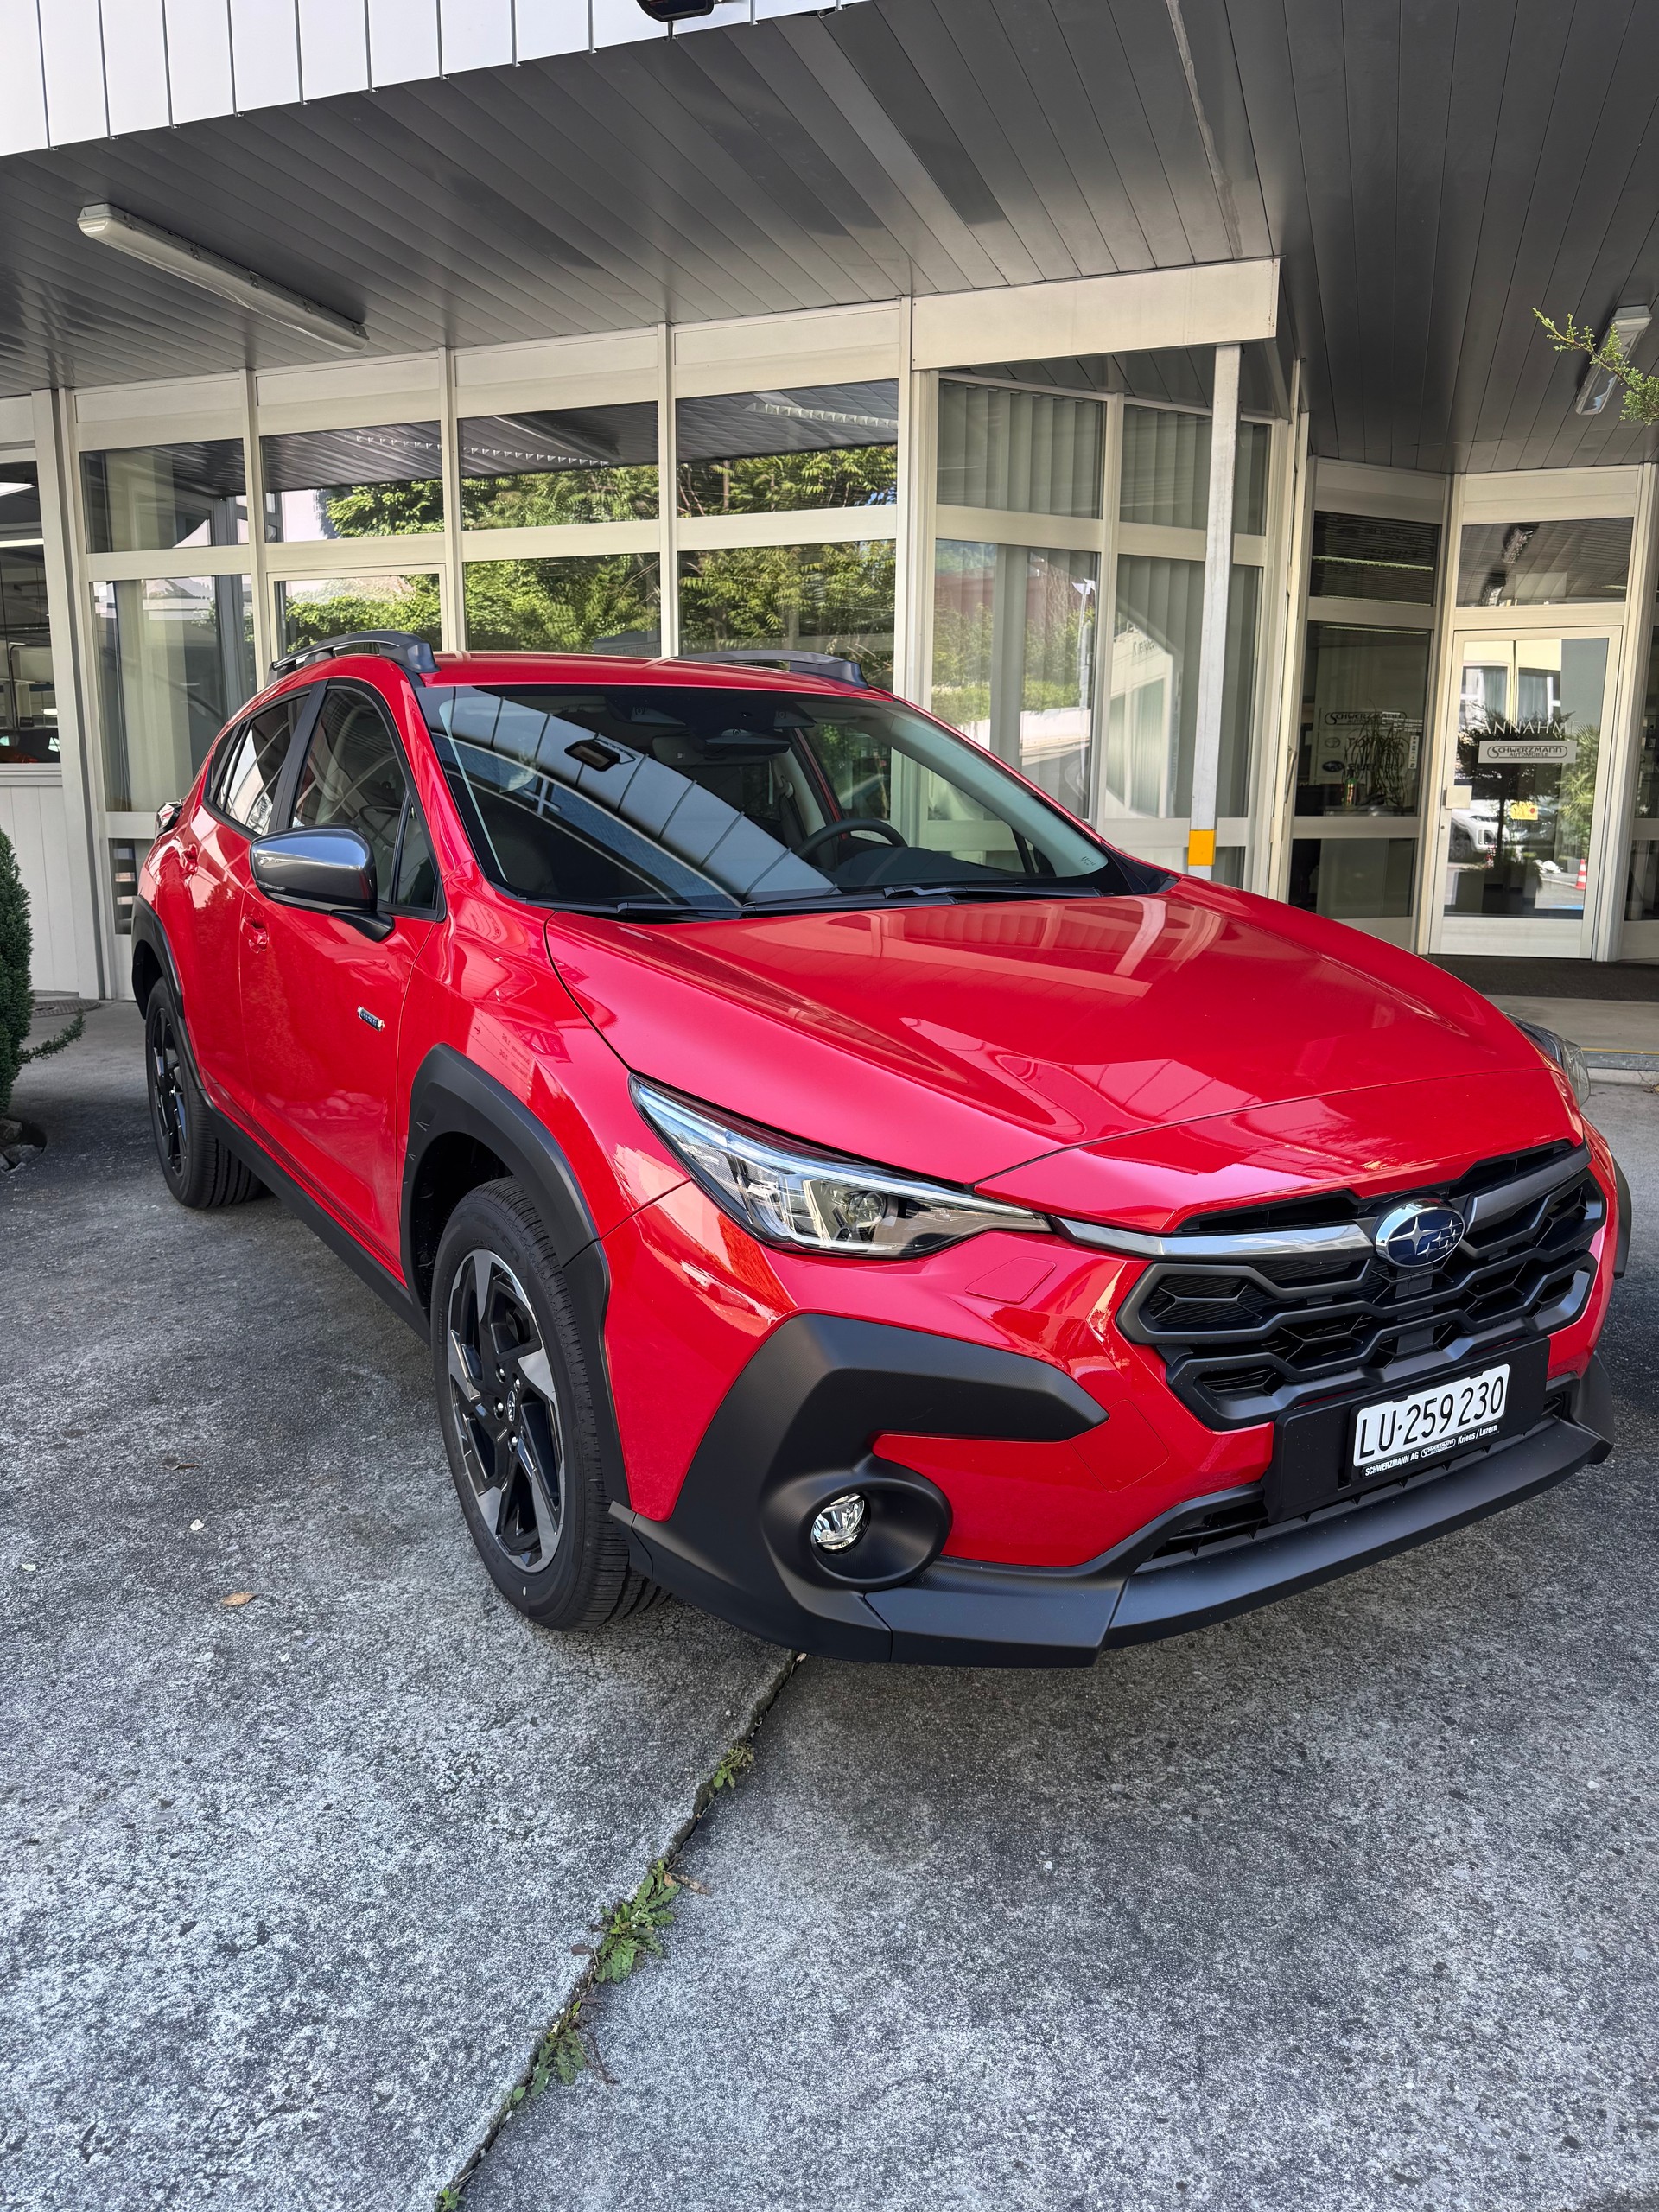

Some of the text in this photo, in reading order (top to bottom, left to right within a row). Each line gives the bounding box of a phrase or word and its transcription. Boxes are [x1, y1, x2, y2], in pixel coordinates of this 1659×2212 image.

[1489, 746, 1562, 758] SCHWERZMANN
[1364, 1452, 1410, 1477] SCHWERZMANN
[1410, 1452, 1420, 1461] AG
[1457, 1433, 1476, 1445] Kriens
[1479, 1424, 1498, 1437] Luzern
